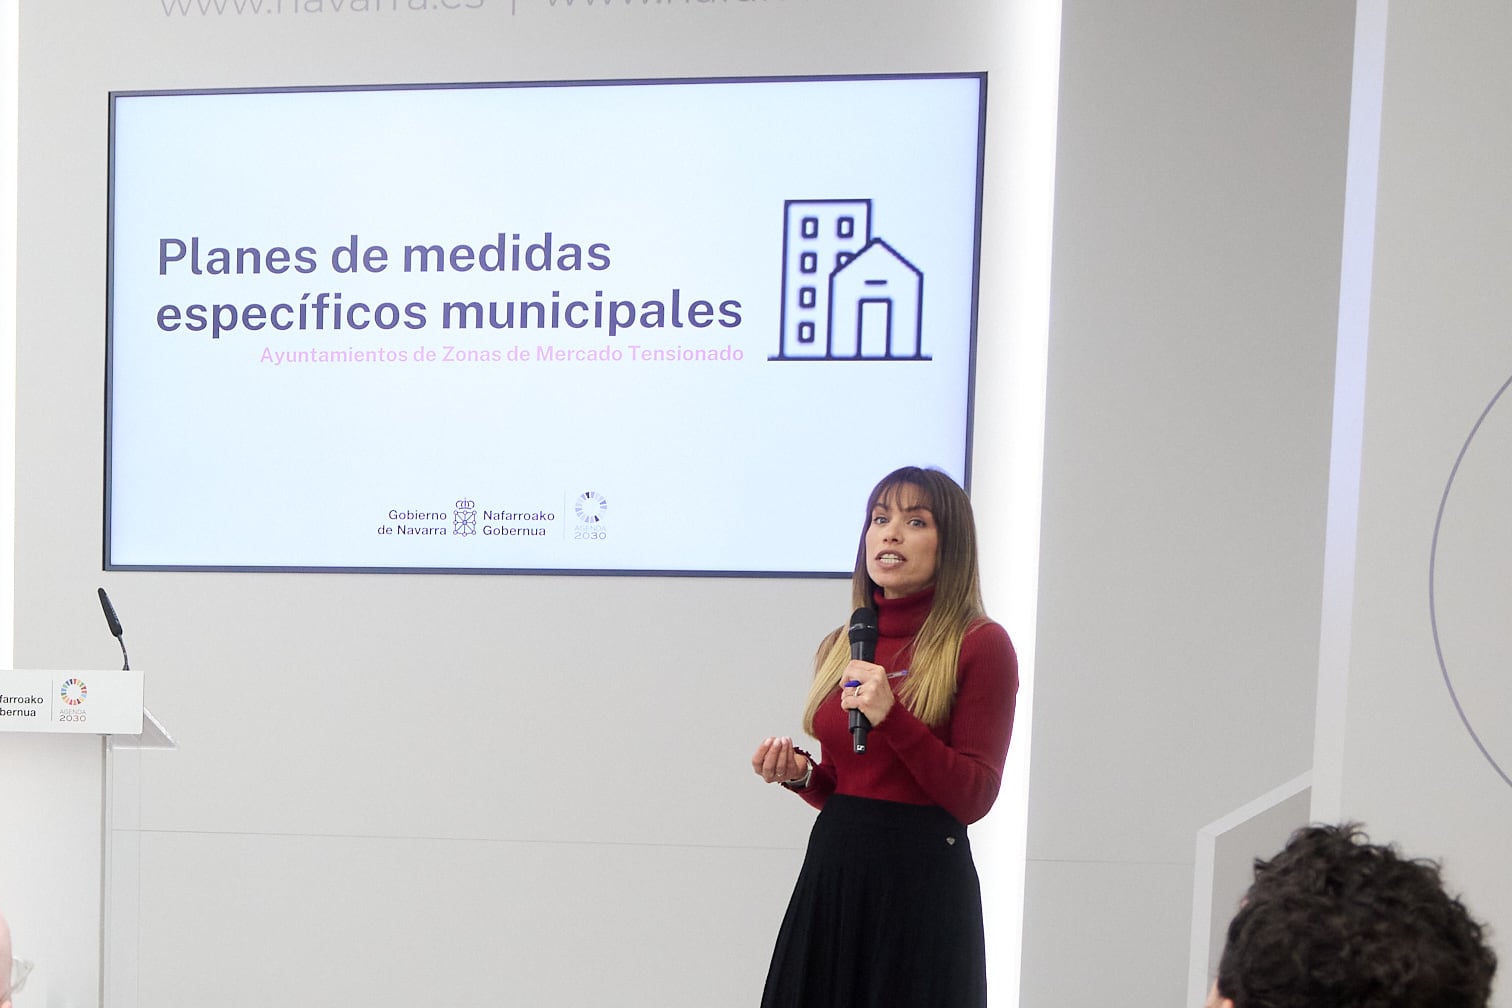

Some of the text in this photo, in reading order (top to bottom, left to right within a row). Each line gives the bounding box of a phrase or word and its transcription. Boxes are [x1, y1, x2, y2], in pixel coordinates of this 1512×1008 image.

[158, 231, 612, 276] Planes de medidas
[155, 287, 743, 340] específicos municipales
[259, 344, 745, 366] Ayuntamientos de Zonas de Mercado Tensionado
[388, 509, 447, 521] Gobierno
[483, 510, 555, 521] Nafarroako
[377, 524, 447, 536] de Navarra
[482, 525, 546, 536] Gobernua
[574, 532, 607, 540] 2030
